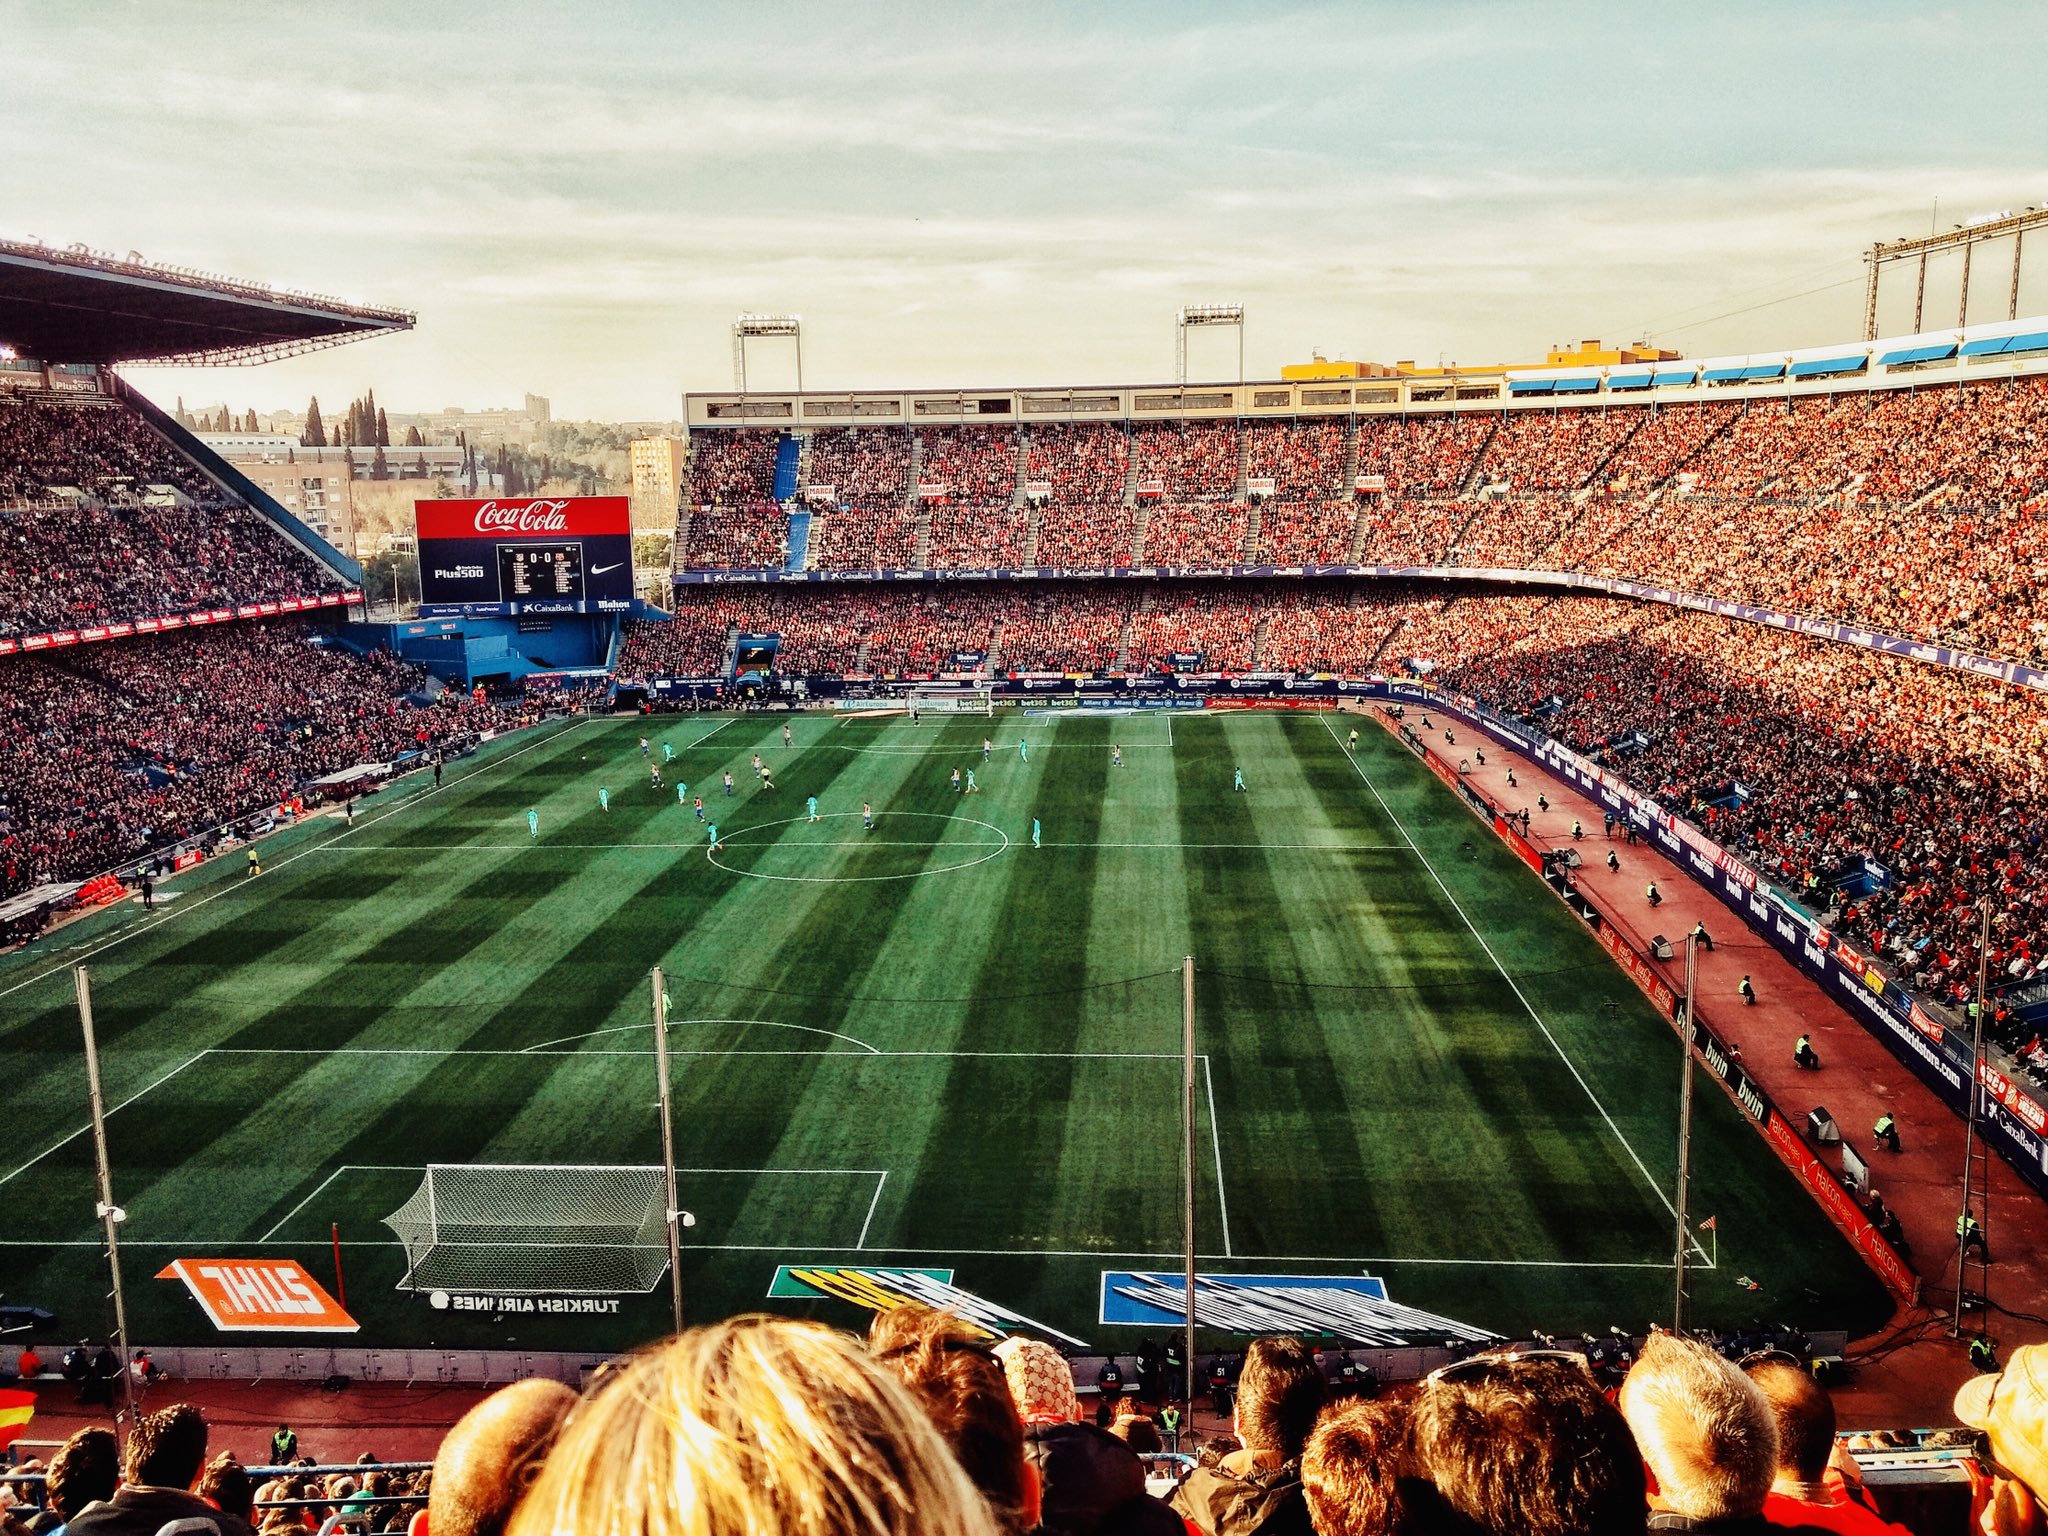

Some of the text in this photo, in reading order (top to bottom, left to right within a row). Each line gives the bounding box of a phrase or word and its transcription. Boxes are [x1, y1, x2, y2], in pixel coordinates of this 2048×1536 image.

[56, 381, 96, 392] Plus500
[1028, 483, 1050, 491] MARCA
[1138, 482, 1162, 490] MARCA
[1250, 480, 1274, 488] MARCA
[1357, 478, 1383, 486] MARCA
[809, 487, 834, 495] MARCA
[474, 500, 570, 532] Coca-Cola
[530, 553, 537, 563] 0
[544, 552, 551, 563] 0
[435, 569, 484, 579] Plus500
[534, 604, 574, 613] CaixaBank
[598, 600, 630, 609] Mahou
[1720, 855, 1755, 890] FABERO
[1726, 874, 1742, 901] bwin
[1750, 893, 1768, 922] bwin
[1776, 914, 1796, 945] bwin
[1804, 937, 1825, 970] bwin
[1838, 971, 1961, 1090] www.atleticodemadridstore.com
[1705, 1038, 1728, 1079] bwin
[1737, 1076, 1764, 1121] bwin
[1999, 1111, 2039, 1161] CaixaBank
[198, 1266, 326, 1314] STIHL
[1764, 1342, 1775, 1351] 28
[1106, 1373, 1116, 1381] 23
[1216, 1367, 1225, 1377] 51
[1343, 1367, 1354, 1376] 107
